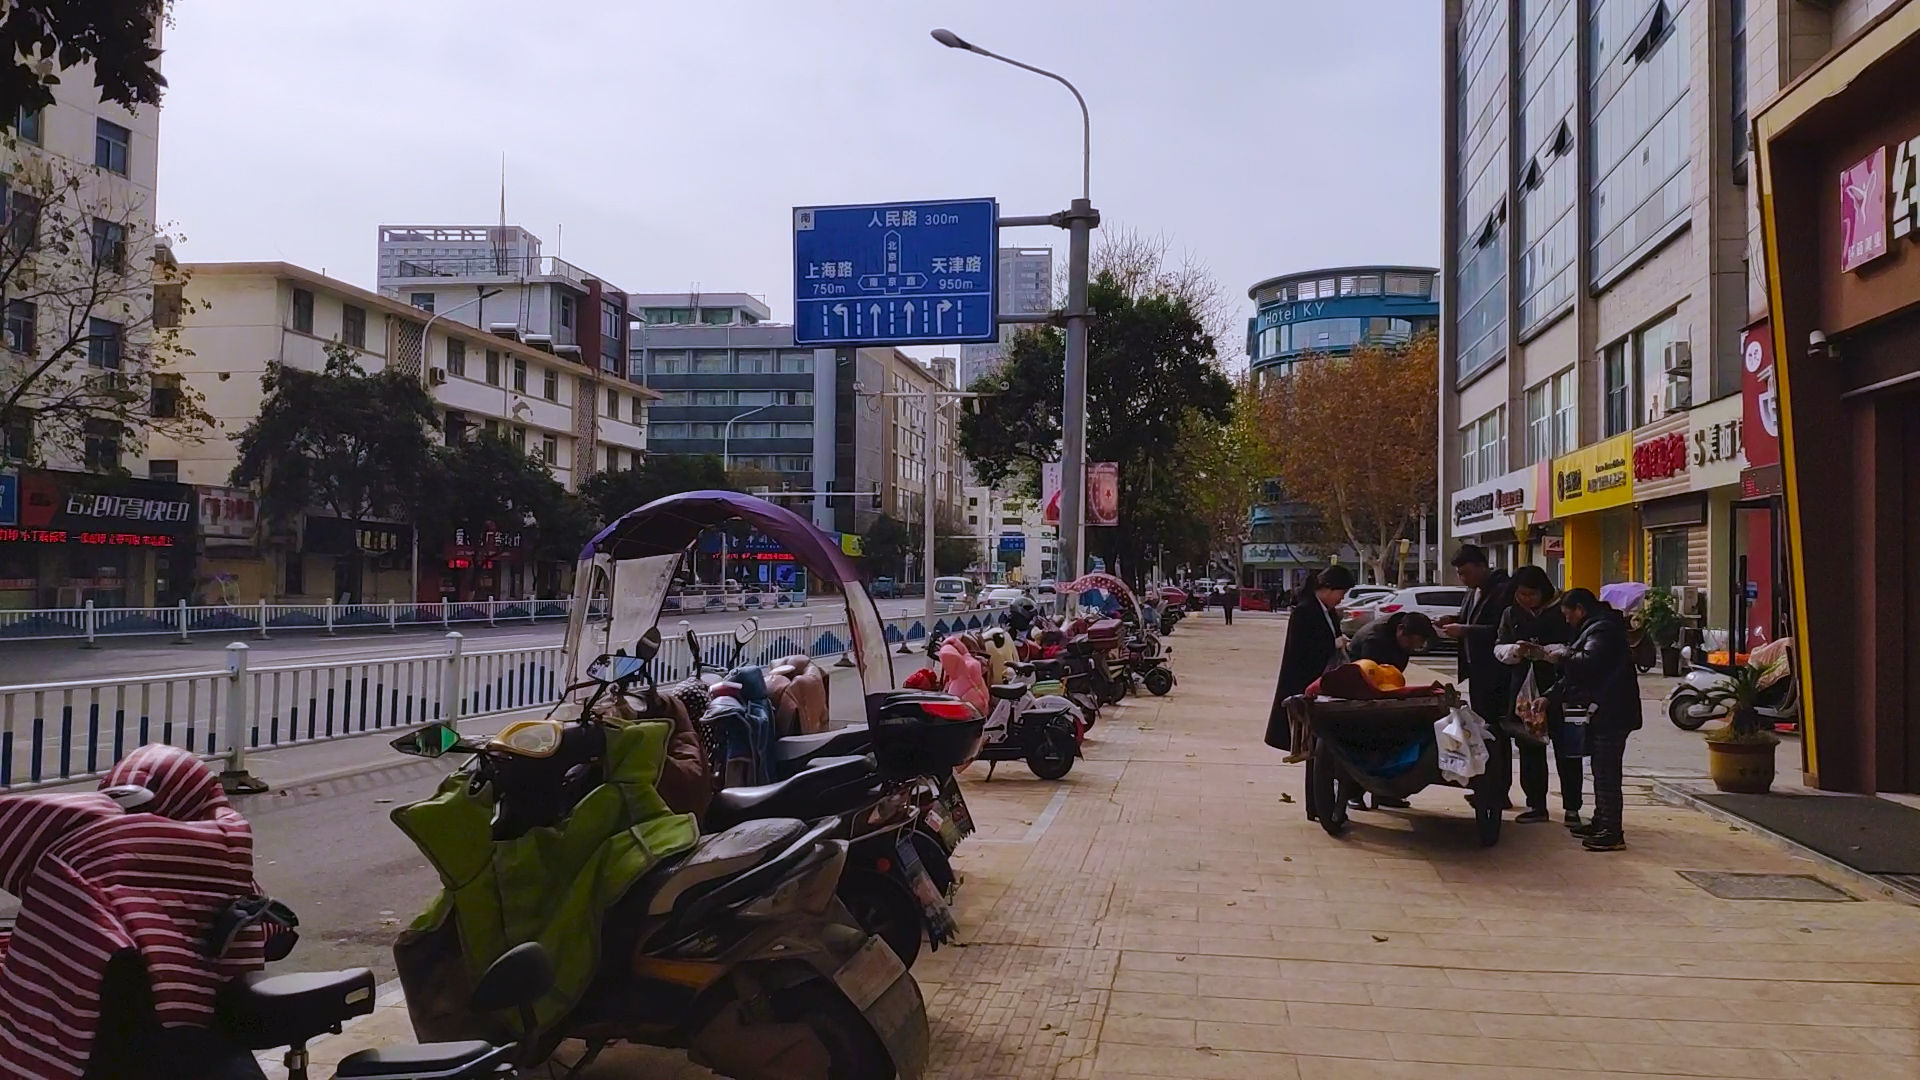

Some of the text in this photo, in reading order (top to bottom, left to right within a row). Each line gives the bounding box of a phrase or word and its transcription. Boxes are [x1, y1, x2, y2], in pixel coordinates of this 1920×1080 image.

[800, 212, 811, 224] 南
[867, 210, 959, 228] 人民路 300m
[886, 240, 898, 273] 北京路
[931, 255, 982, 275] 天津路
[804, 261, 853, 279] 上海路
[812, 283, 846, 295] 750m
[939, 278, 974, 291] 950m
[1265, 301, 1325, 325] Hotel KY
